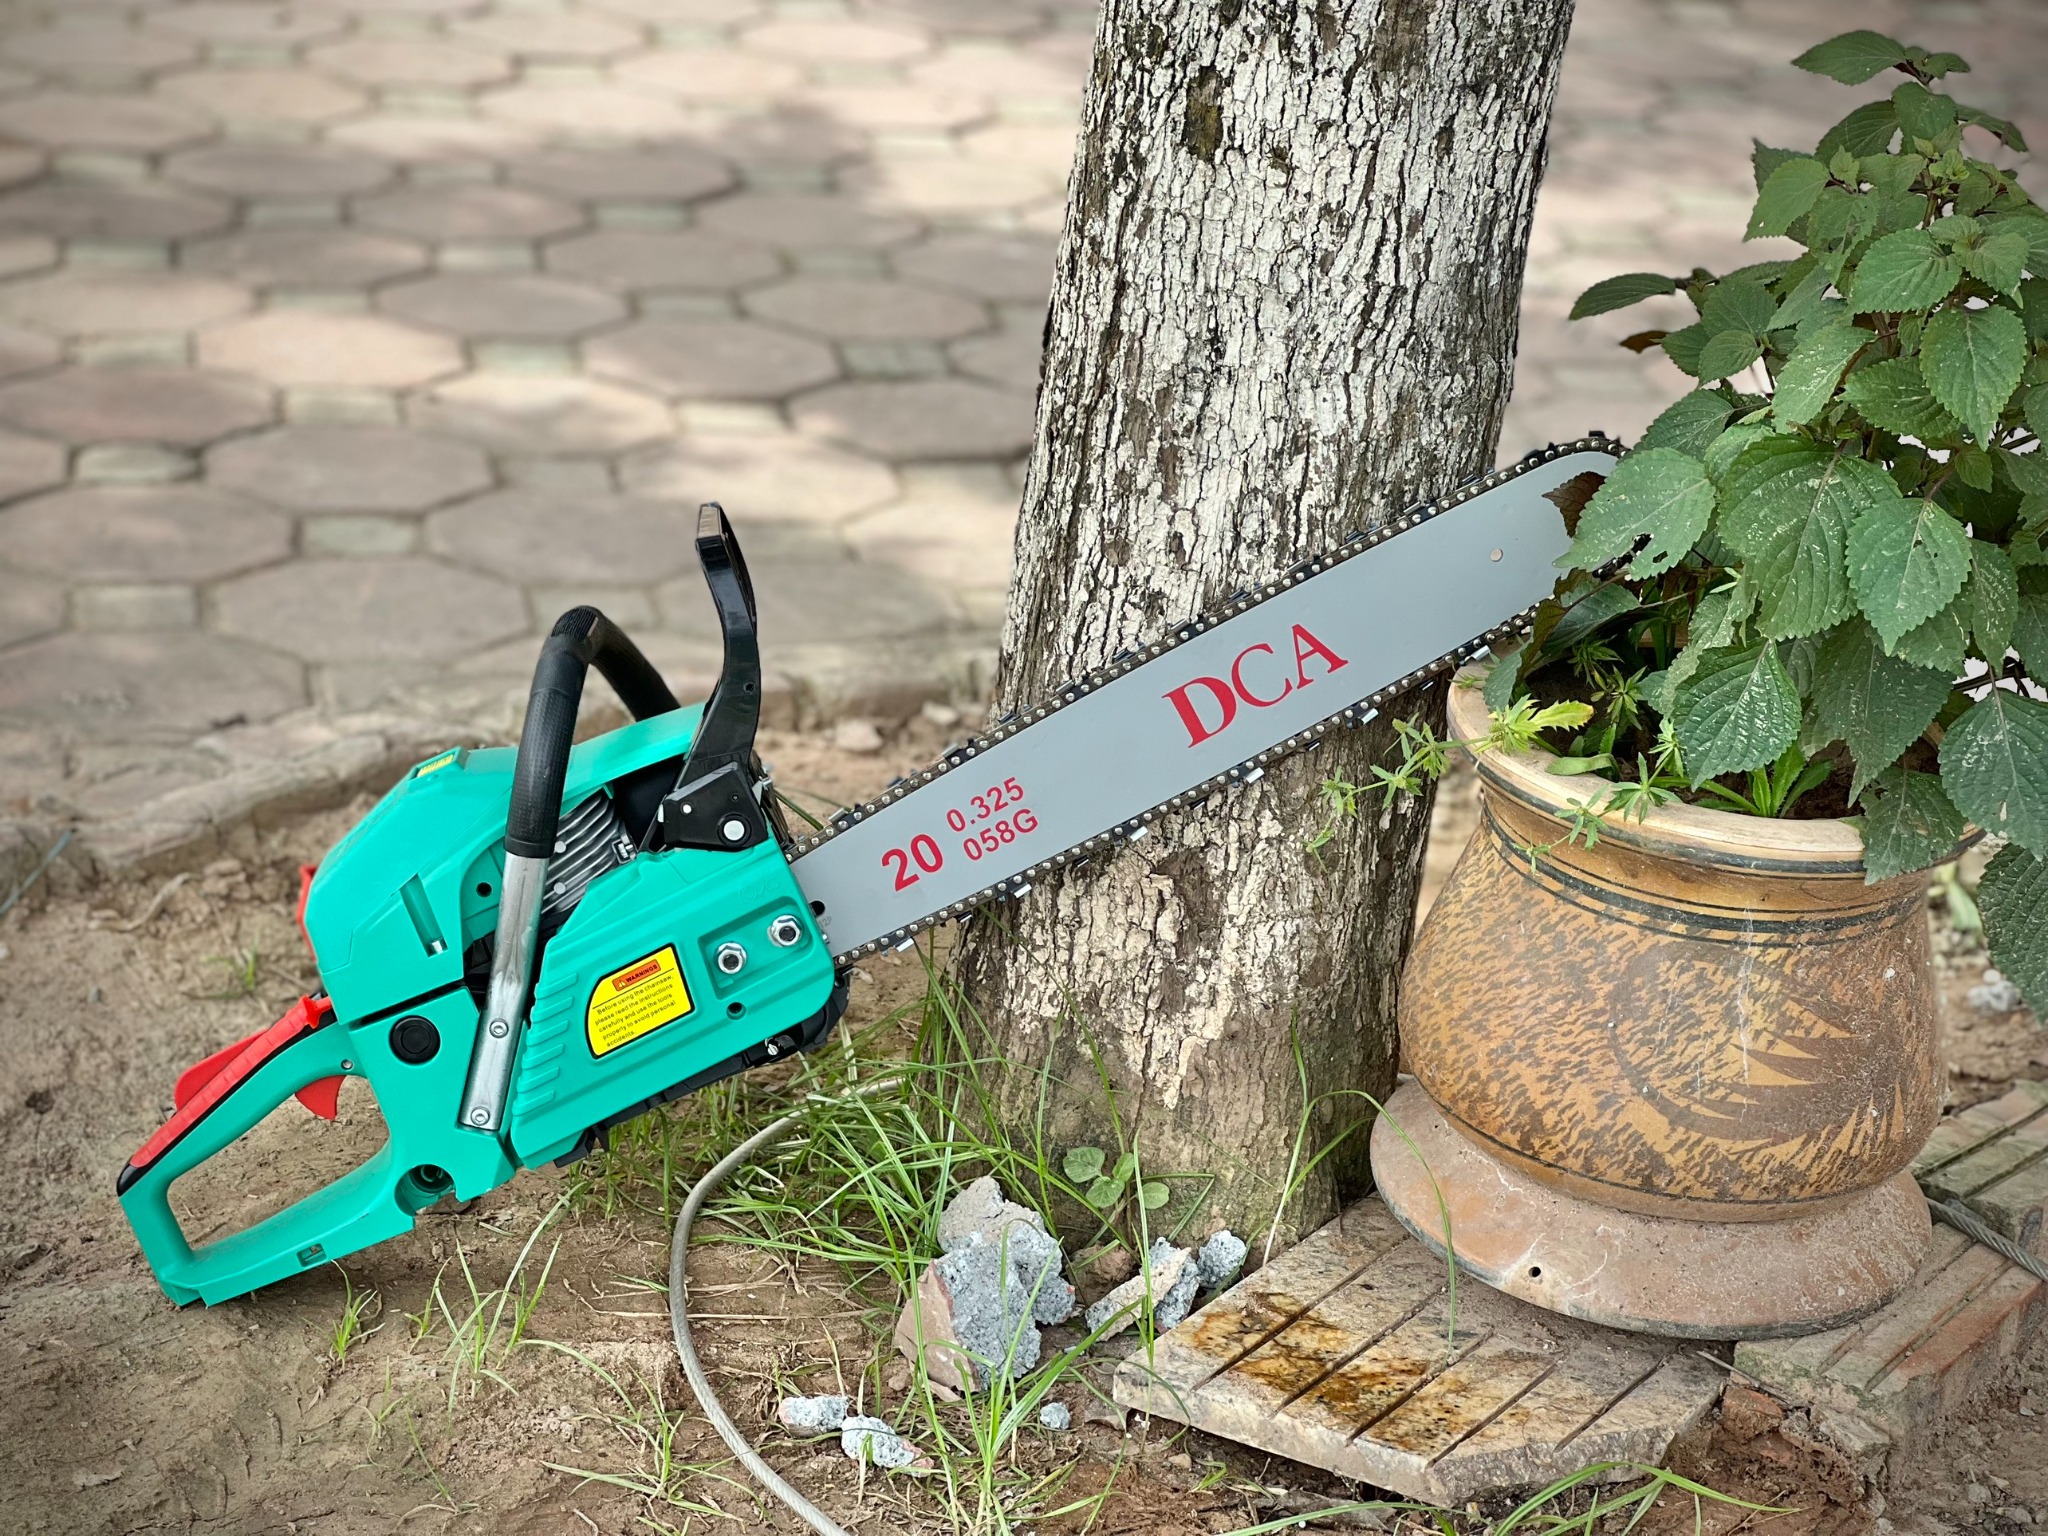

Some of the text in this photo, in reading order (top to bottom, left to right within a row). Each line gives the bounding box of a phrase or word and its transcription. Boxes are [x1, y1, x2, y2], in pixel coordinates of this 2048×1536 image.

[1165, 624, 1349, 747] DCA
[947, 777, 1025, 833] 0.325
[963, 808, 1039, 861] 058G
[881, 833, 944, 892] 20
[594, 983, 673, 1026] please read the instructions
[596, 1002, 617, 1015] Before
[617, 993, 634, 1005] using
[633, 988, 644, 996] the
[598, 993, 673, 1033] carefully and use the tools
[602, 1025, 627, 1041] properly
[633, 1012, 650, 1024] avoid
[650, 999, 676, 1017] personal
